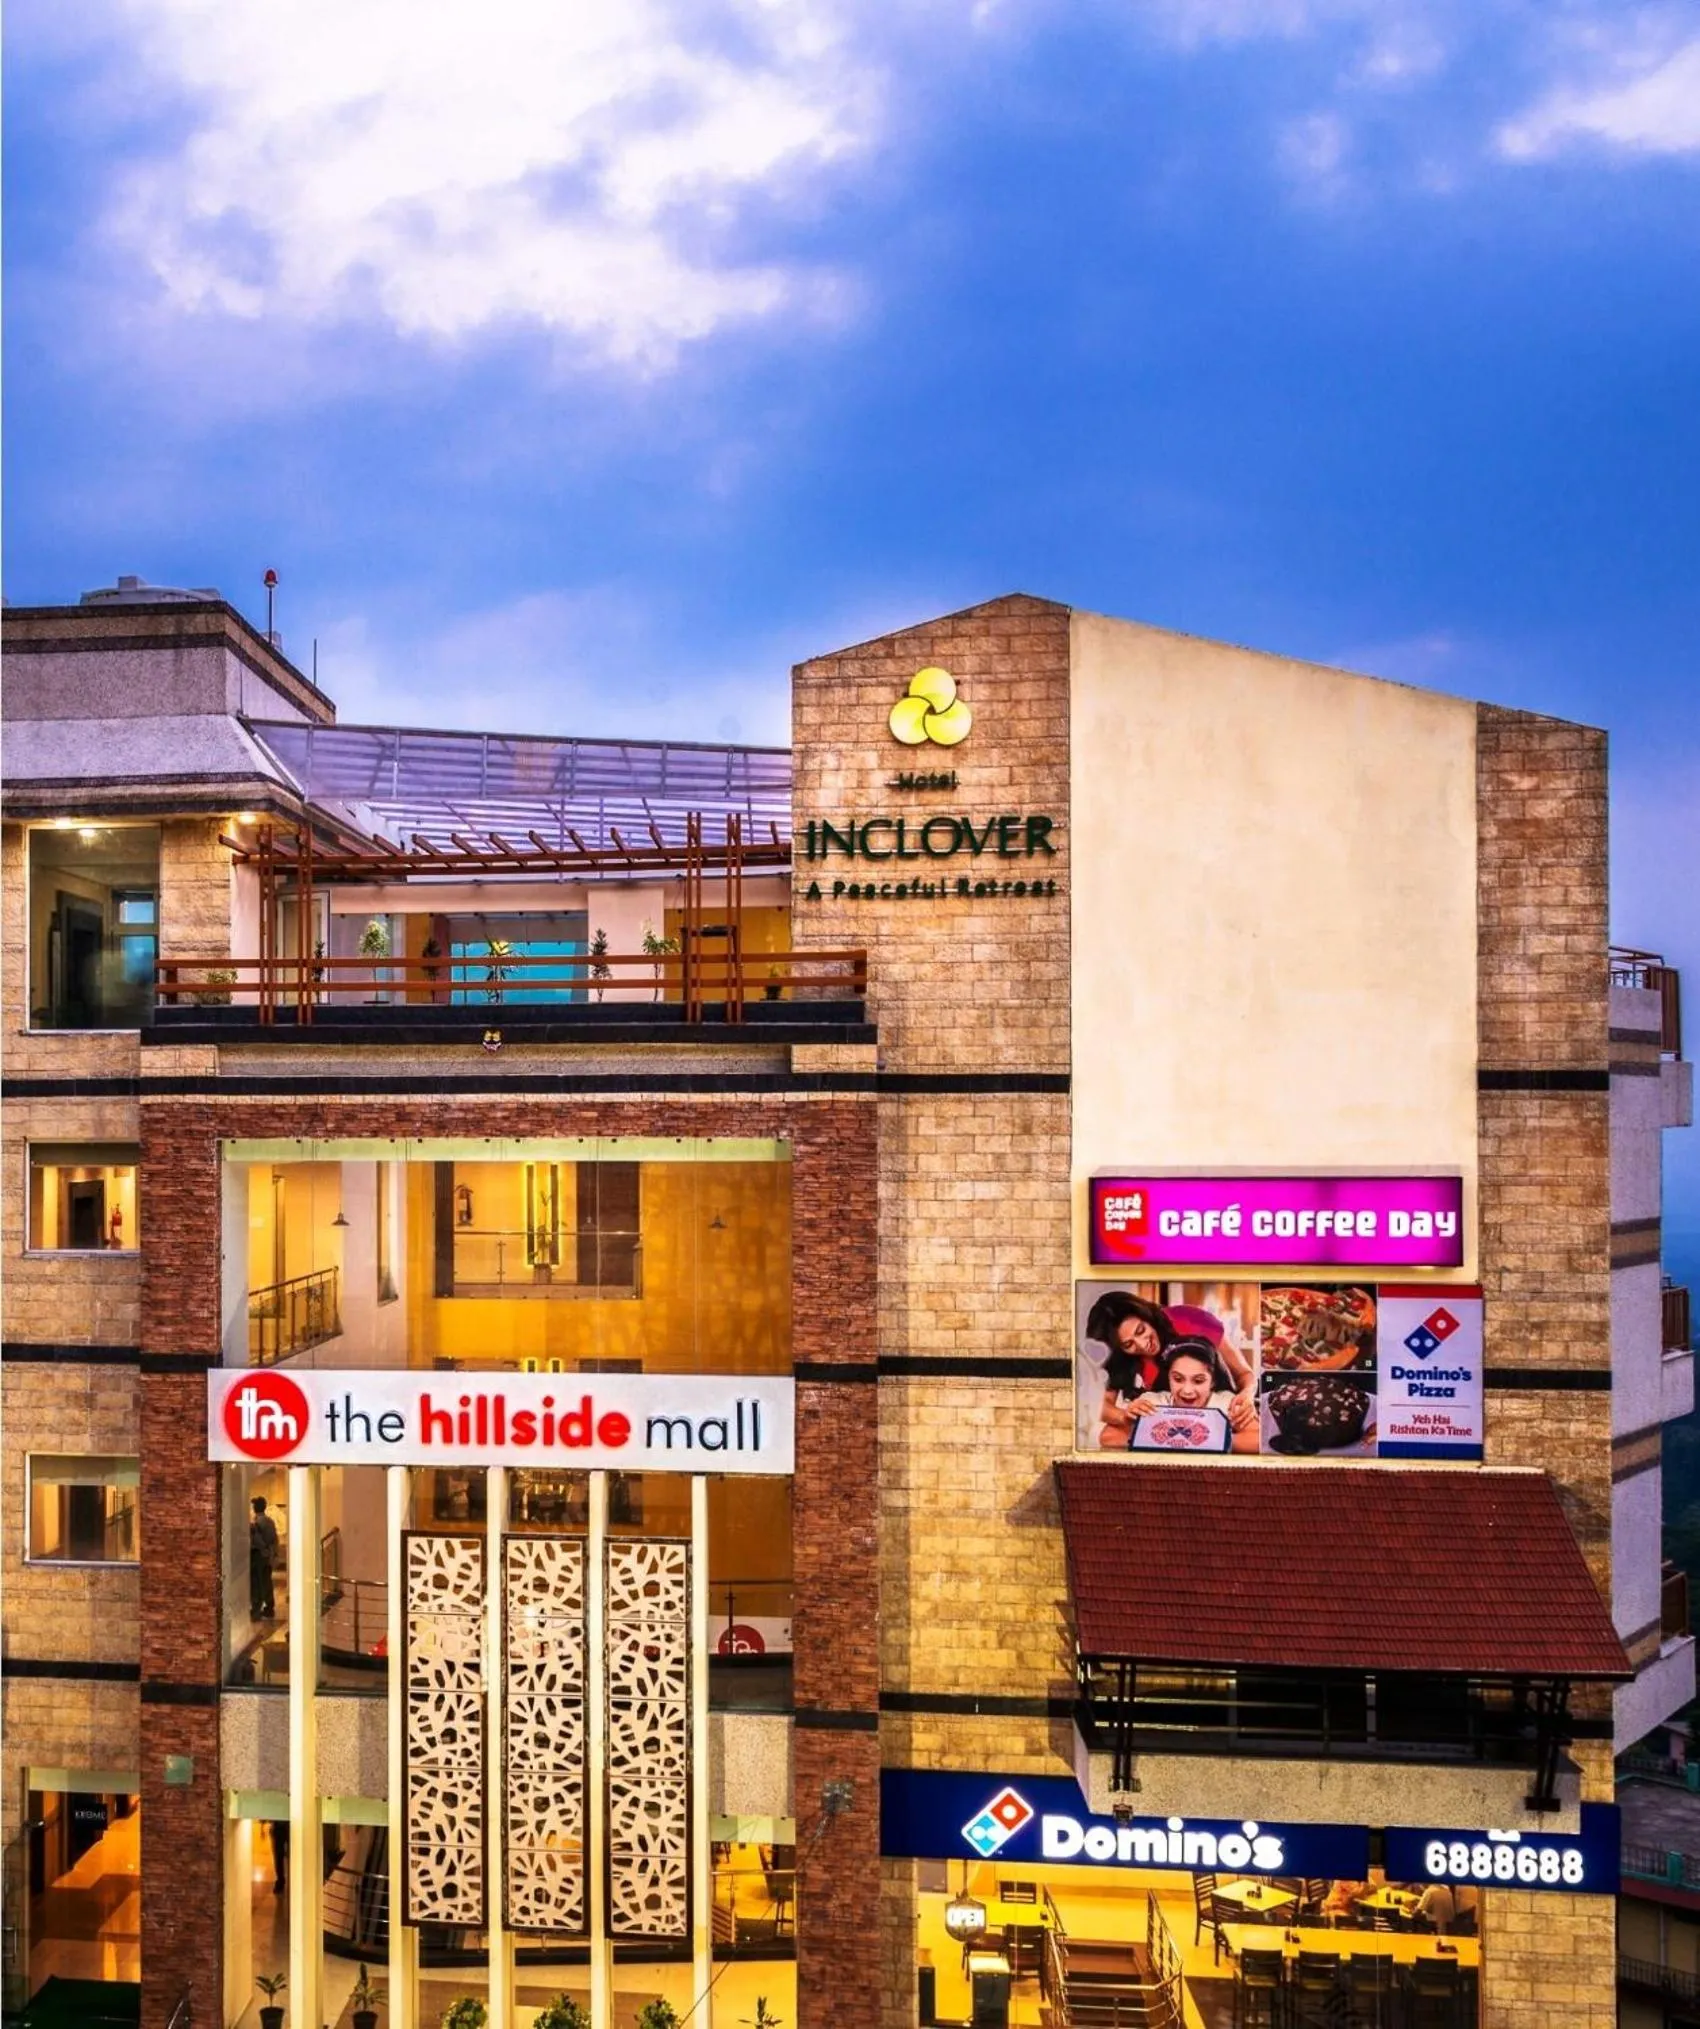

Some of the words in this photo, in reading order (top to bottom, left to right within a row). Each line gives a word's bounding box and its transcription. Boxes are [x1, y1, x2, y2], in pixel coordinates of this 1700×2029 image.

[899, 770, 958, 790] Hotel
[807, 816, 1057, 862] INCLOVER
[806, 880, 822, 900] A
[833, 877, 947, 900] Peaceful
[957, 877, 1057, 898] Retreat
[1391, 1366, 1472, 1382] Domino's
[1408, 1383, 1456, 1398] Pizza
[325, 1394, 405, 1443] the
[420, 1394, 631, 1448] hillside
[646, 1398, 761, 1452] mall
[1390, 1424, 1429, 1435] Rishton
[1431, 1426, 1445, 1435] Ka
[1446, 1426, 1472, 1436] Time
[1042, 1815, 1285, 1869] Domino's
[1426, 1841, 1584, 1884] 6888688
[947, 1908, 984, 1927] OPEN
